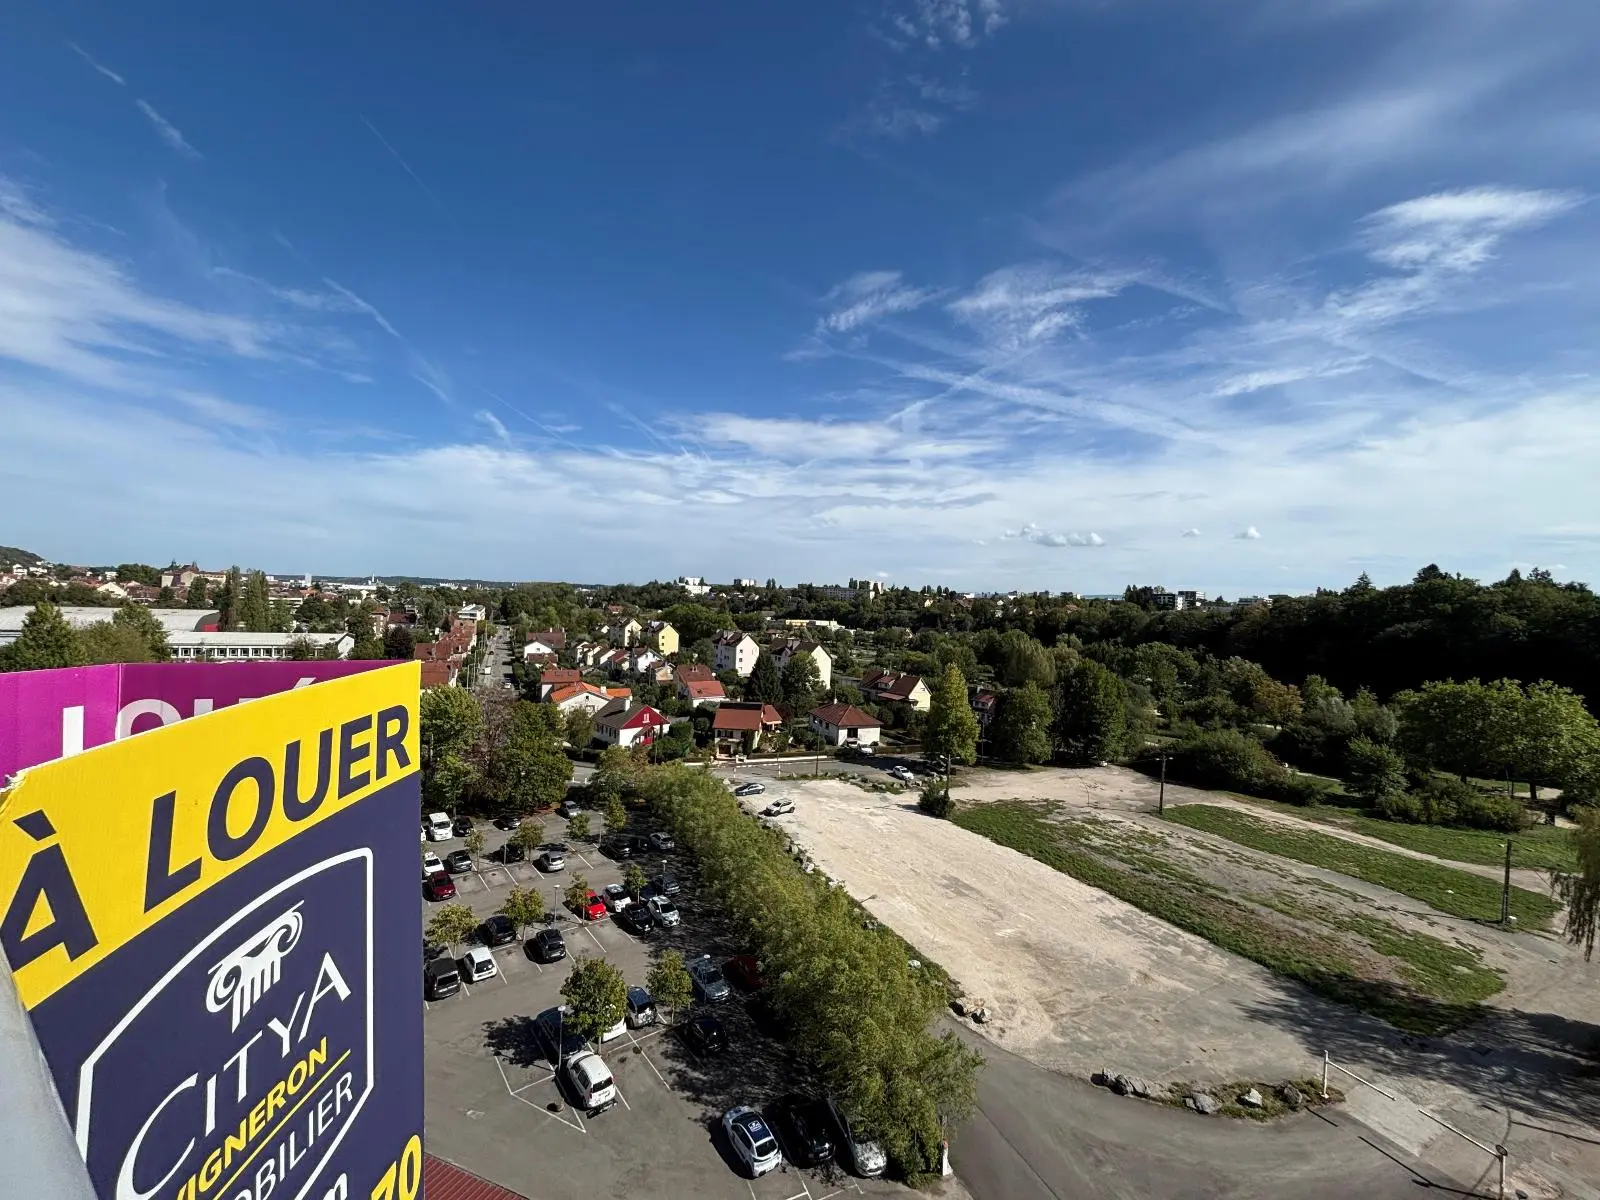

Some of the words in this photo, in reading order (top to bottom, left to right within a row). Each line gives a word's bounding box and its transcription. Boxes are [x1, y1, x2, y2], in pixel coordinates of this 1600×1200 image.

[0, 809, 99, 972] À
[144, 704, 412, 914] LOUER
[115, 952, 352, 1200] CITYA
[234, 1071, 353, 1200] BILIER
